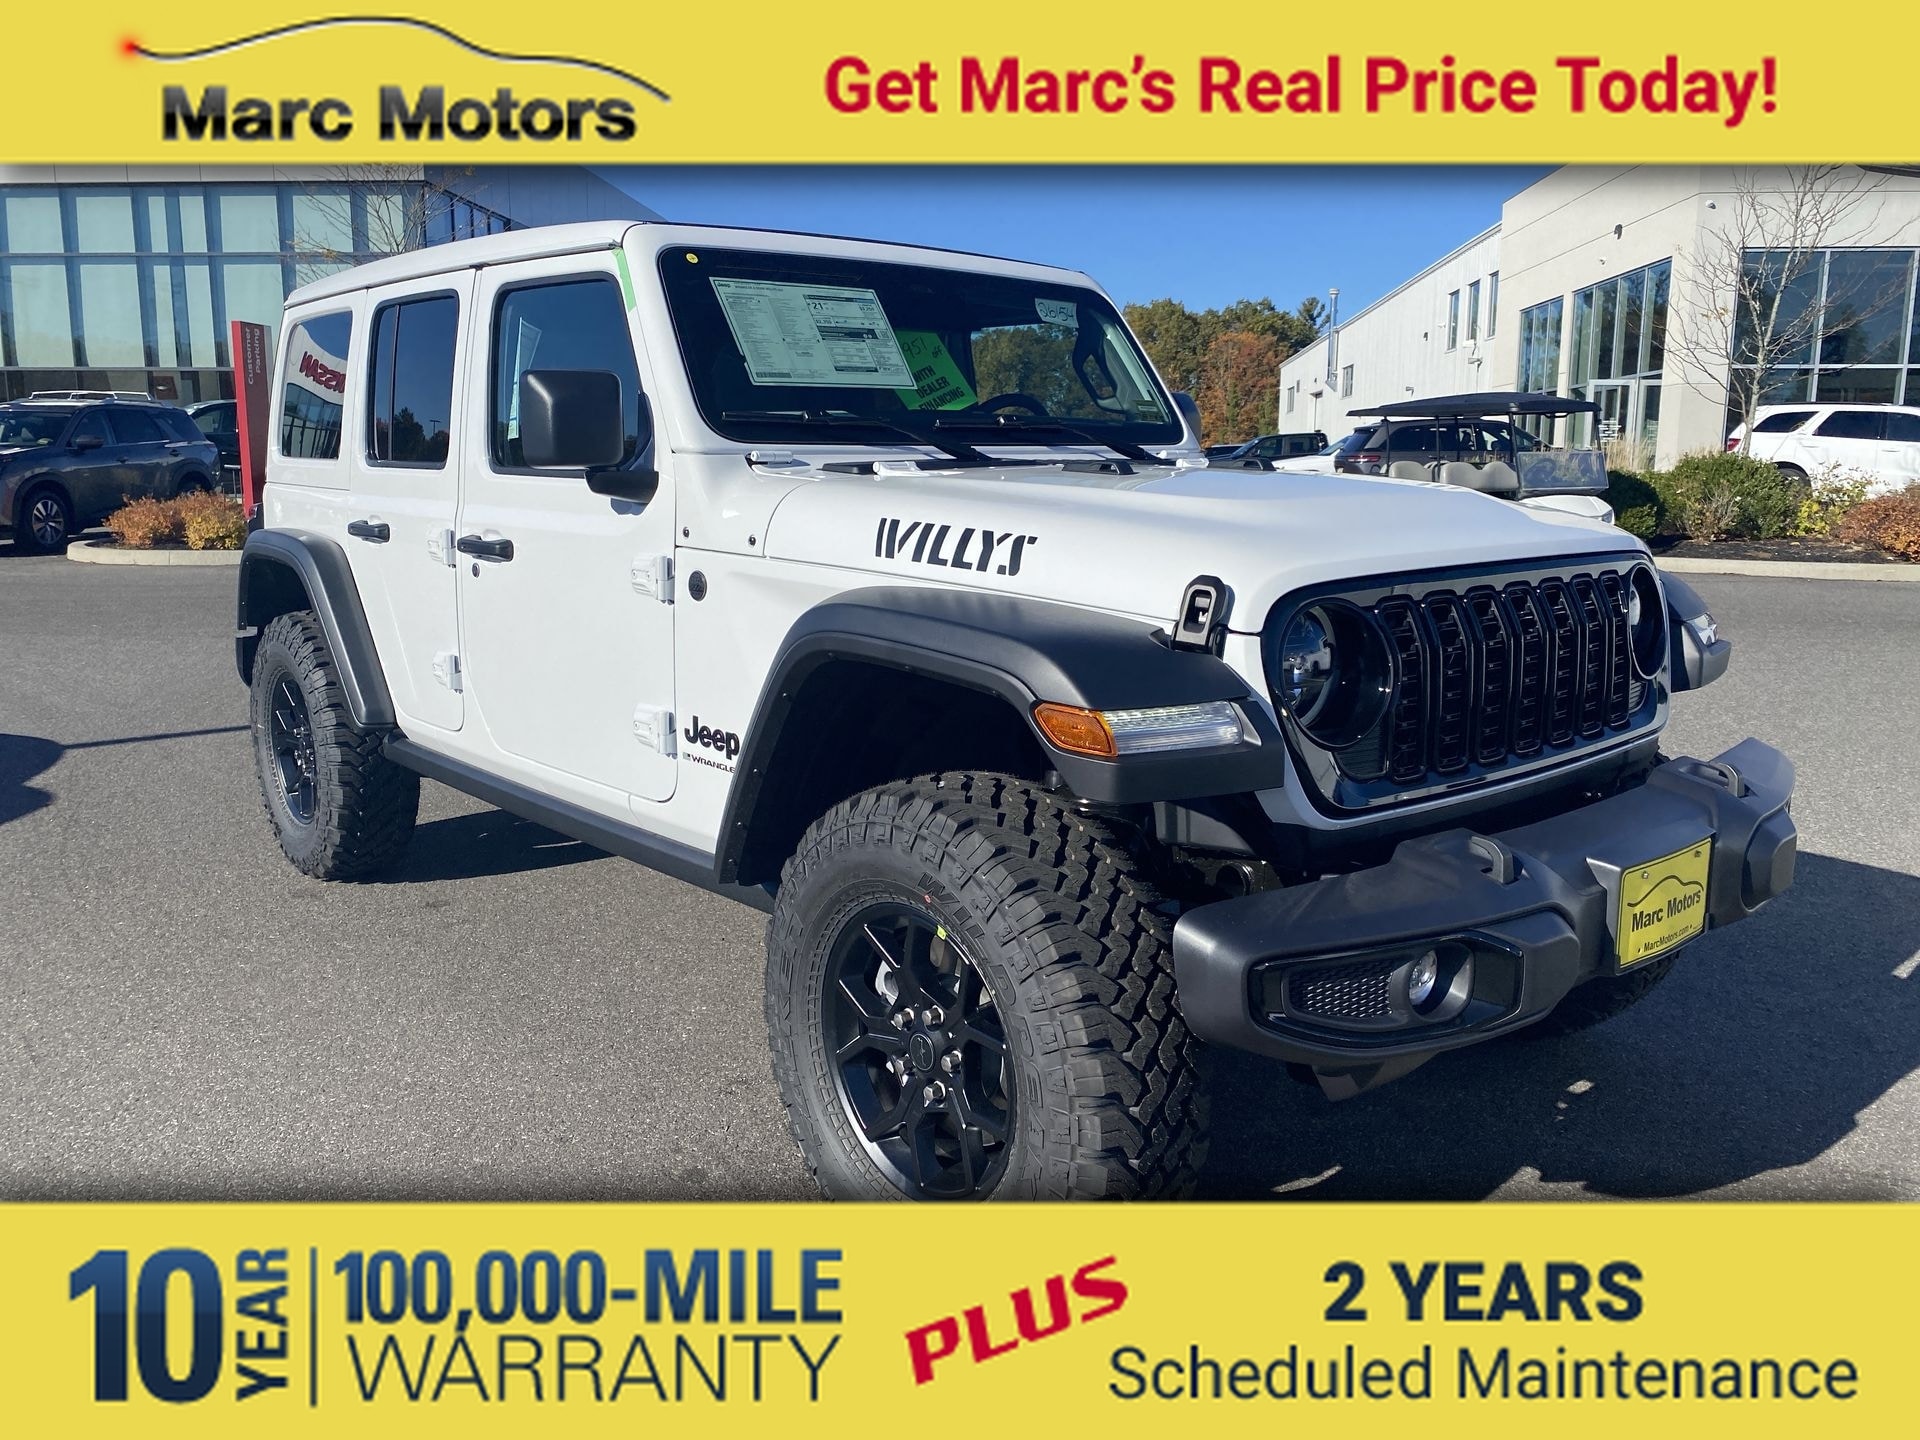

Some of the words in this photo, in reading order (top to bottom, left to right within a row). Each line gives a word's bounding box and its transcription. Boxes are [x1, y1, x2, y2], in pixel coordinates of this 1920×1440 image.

[245, 327, 254, 385] Customer
[912, 365, 936, 383] WITH
[915, 376, 950, 399] DEALER
[875, 517, 1039, 577] WILLYS
[684, 714, 740, 760] Jeep
[691, 754, 736, 774] WRANGLE
[1631, 908, 1664, 932] Marc
[1667, 889, 1702, 918] Motors
[1643, 925, 1690, 953] MarcMotors.com
